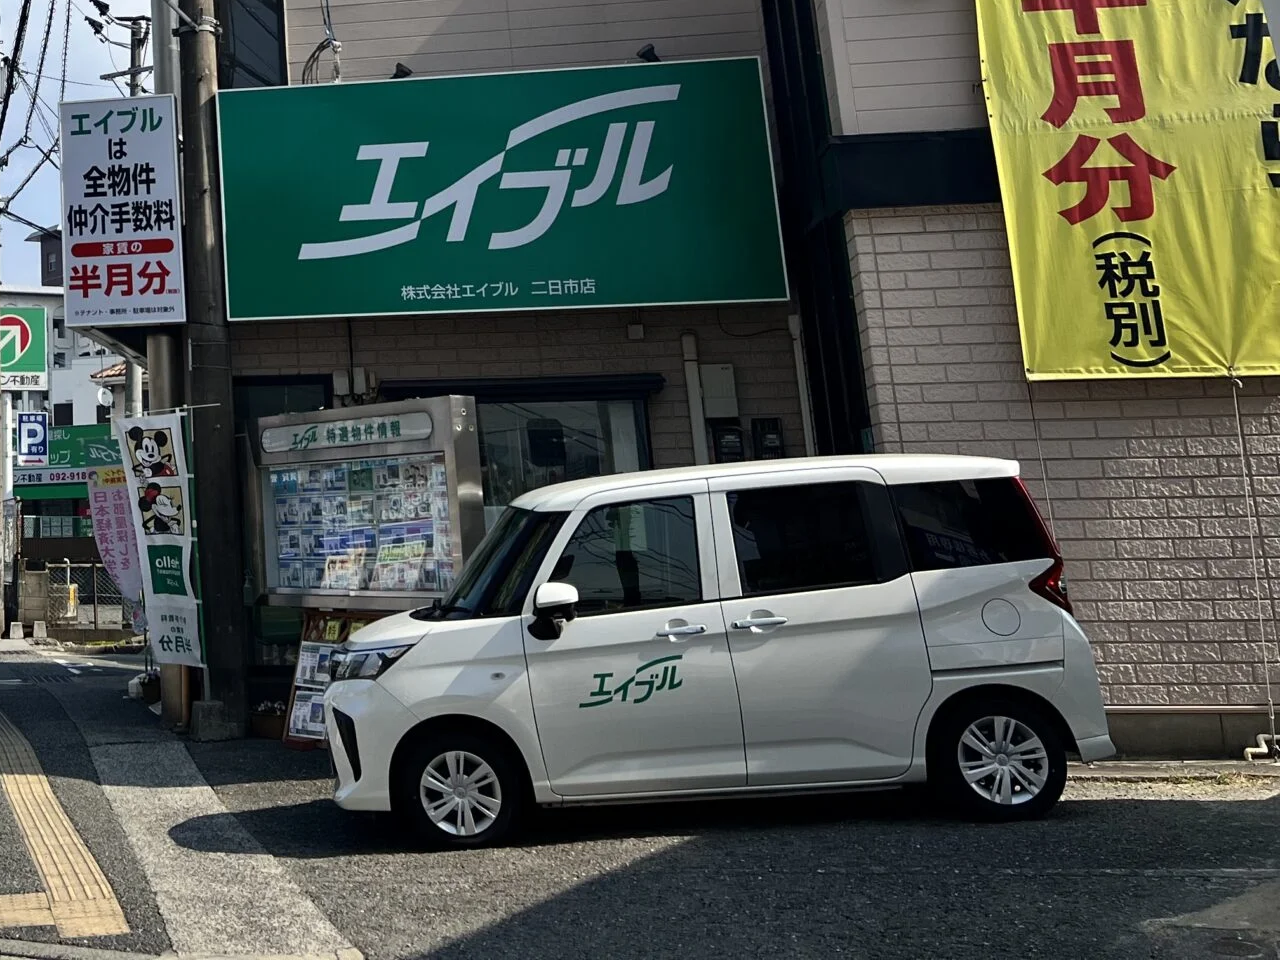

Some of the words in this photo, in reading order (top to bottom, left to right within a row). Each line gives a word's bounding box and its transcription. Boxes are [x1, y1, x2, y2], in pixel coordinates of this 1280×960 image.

[71, 107, 162, 136] エイブル
[108, 138, 127, 160] は
[83, 163, 156, 198] 全物件
[298, 84, 680, 260] エイブル
[68, 199, 175, 236] 仲介手数料
[103, 241, 142, 255] 家賃の
[69, 260, 170, 298] 半月分
[401, 281, 519, 300] 株式会社エイブル
[531, 278, 596, 295] 二日市店
[21, 422, 45, 454] P
[288, 425, 318, 451] エイブル
[579, 655, 683, 708] エイブル
